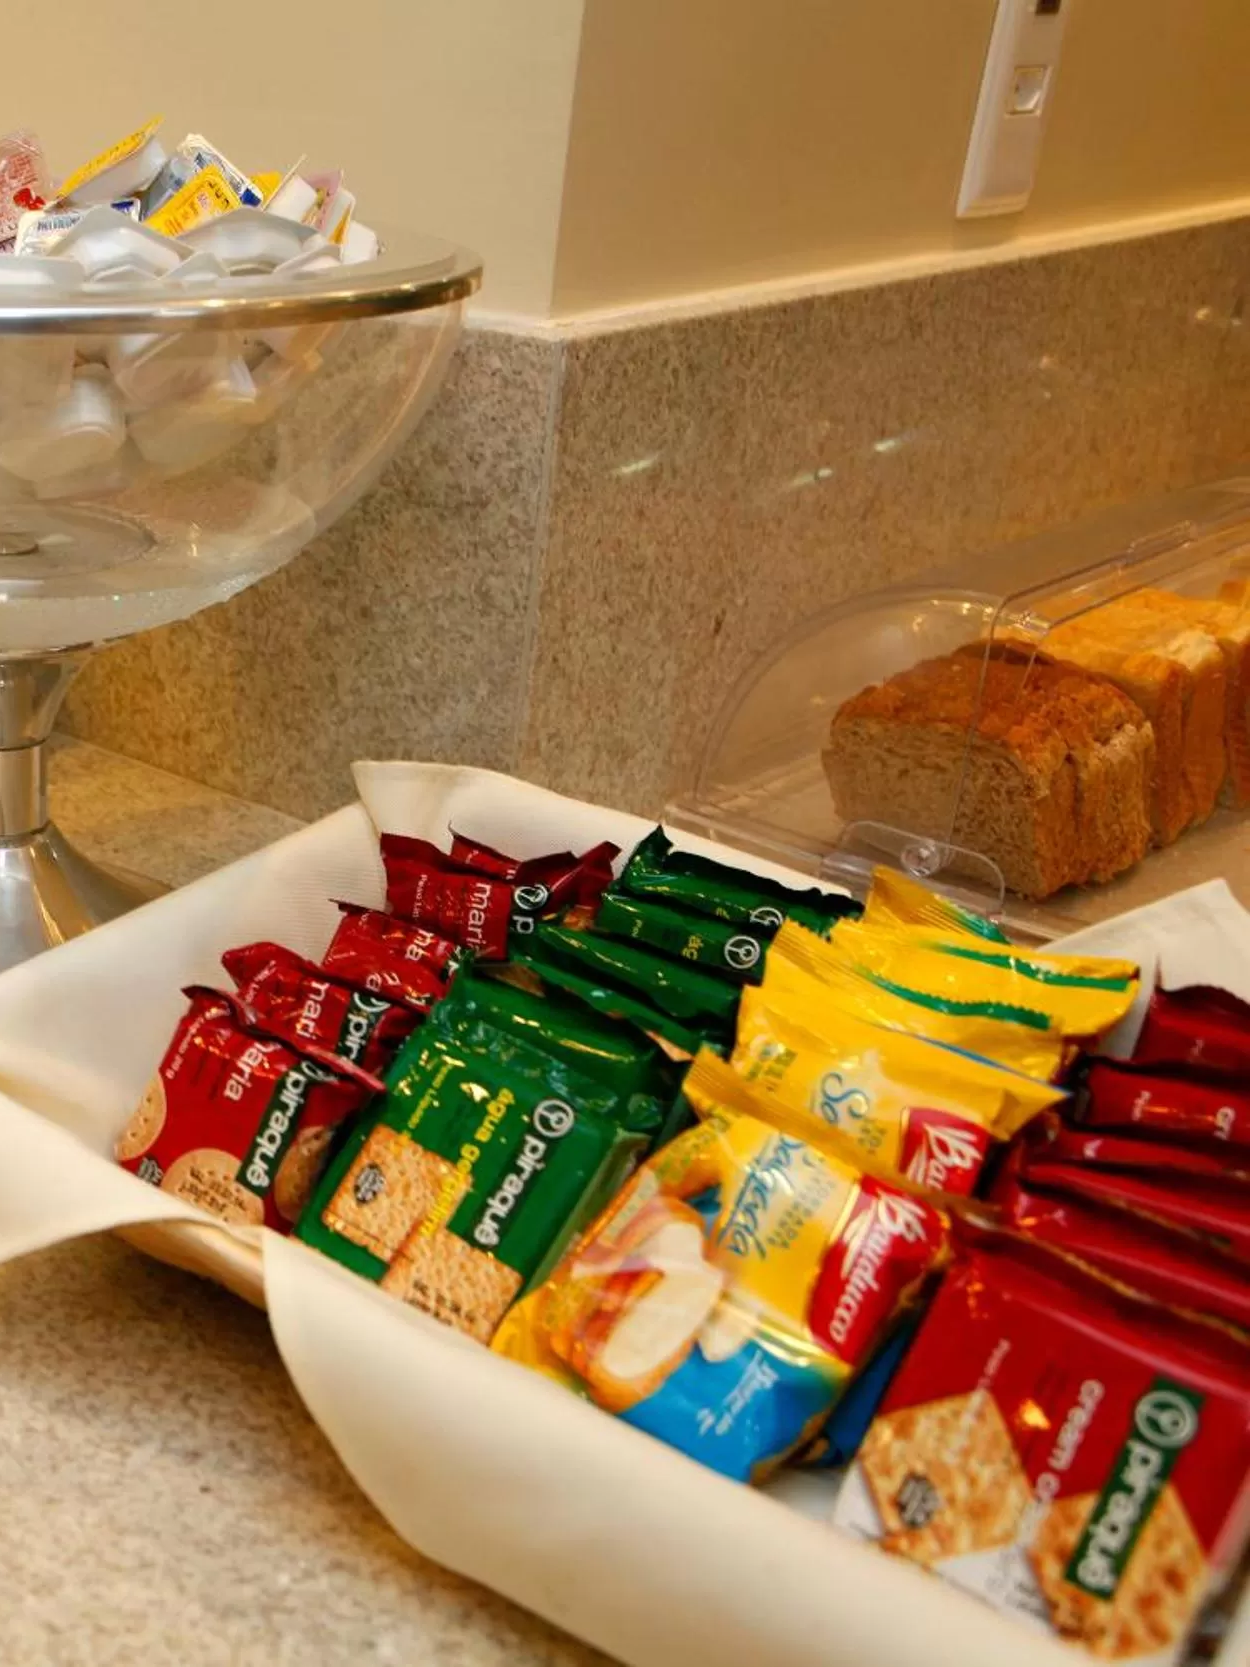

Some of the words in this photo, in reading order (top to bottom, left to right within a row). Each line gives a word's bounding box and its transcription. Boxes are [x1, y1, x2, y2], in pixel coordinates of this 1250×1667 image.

[466, 882, 492, 949] mari
[295, 980, 331, 1040] mari
[245, 1069, 308, 1188] piraquê
[473, 1133, 548, 1246] piraquê
[829, 1187, 928, 1345] Bauducco
[1076, 1438, 1164, 1592] piraquê
